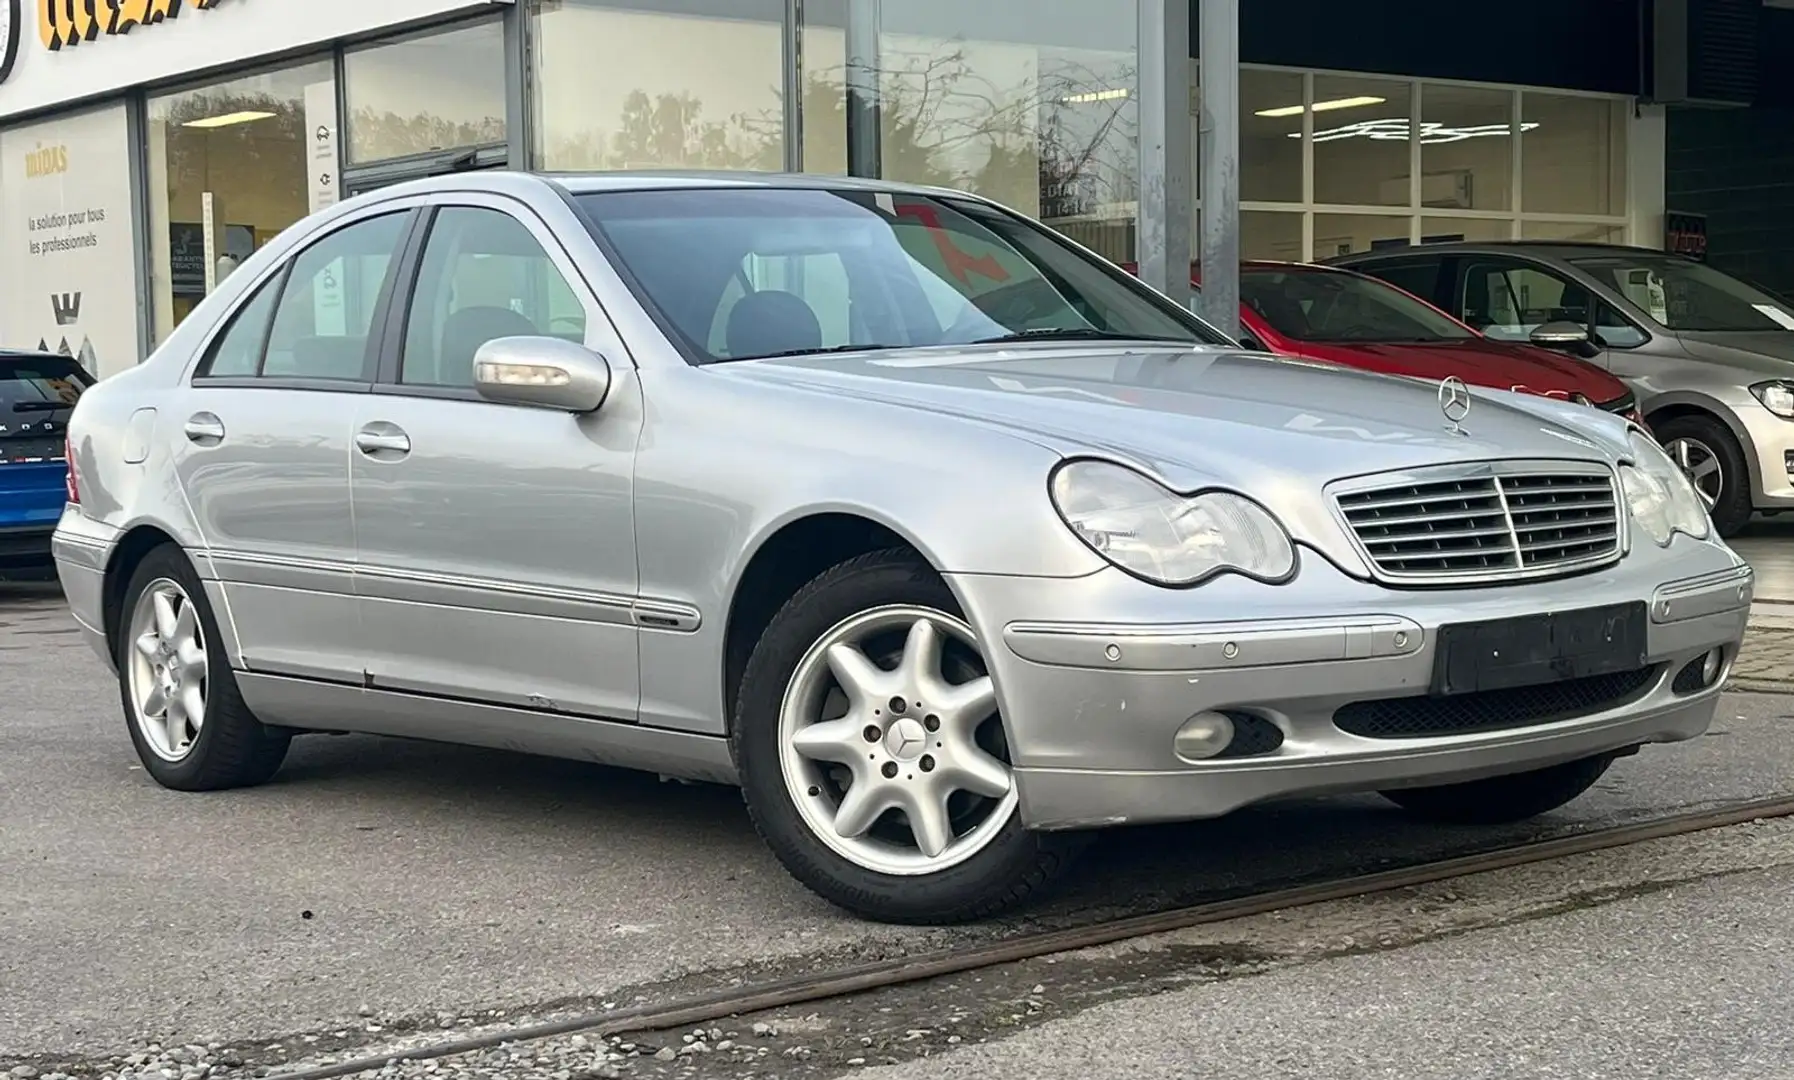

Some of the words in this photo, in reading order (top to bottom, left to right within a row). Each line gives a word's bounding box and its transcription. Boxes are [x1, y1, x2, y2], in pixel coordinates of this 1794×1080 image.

[29, 217, 36, 231] la
[37, 213, 67, 229] solution
[68, 212, 86, 229] pour
[87, 208, 105, 223] tous
[29, 240, 40, 254] les
[42, 232, 98, 257] professionnels
